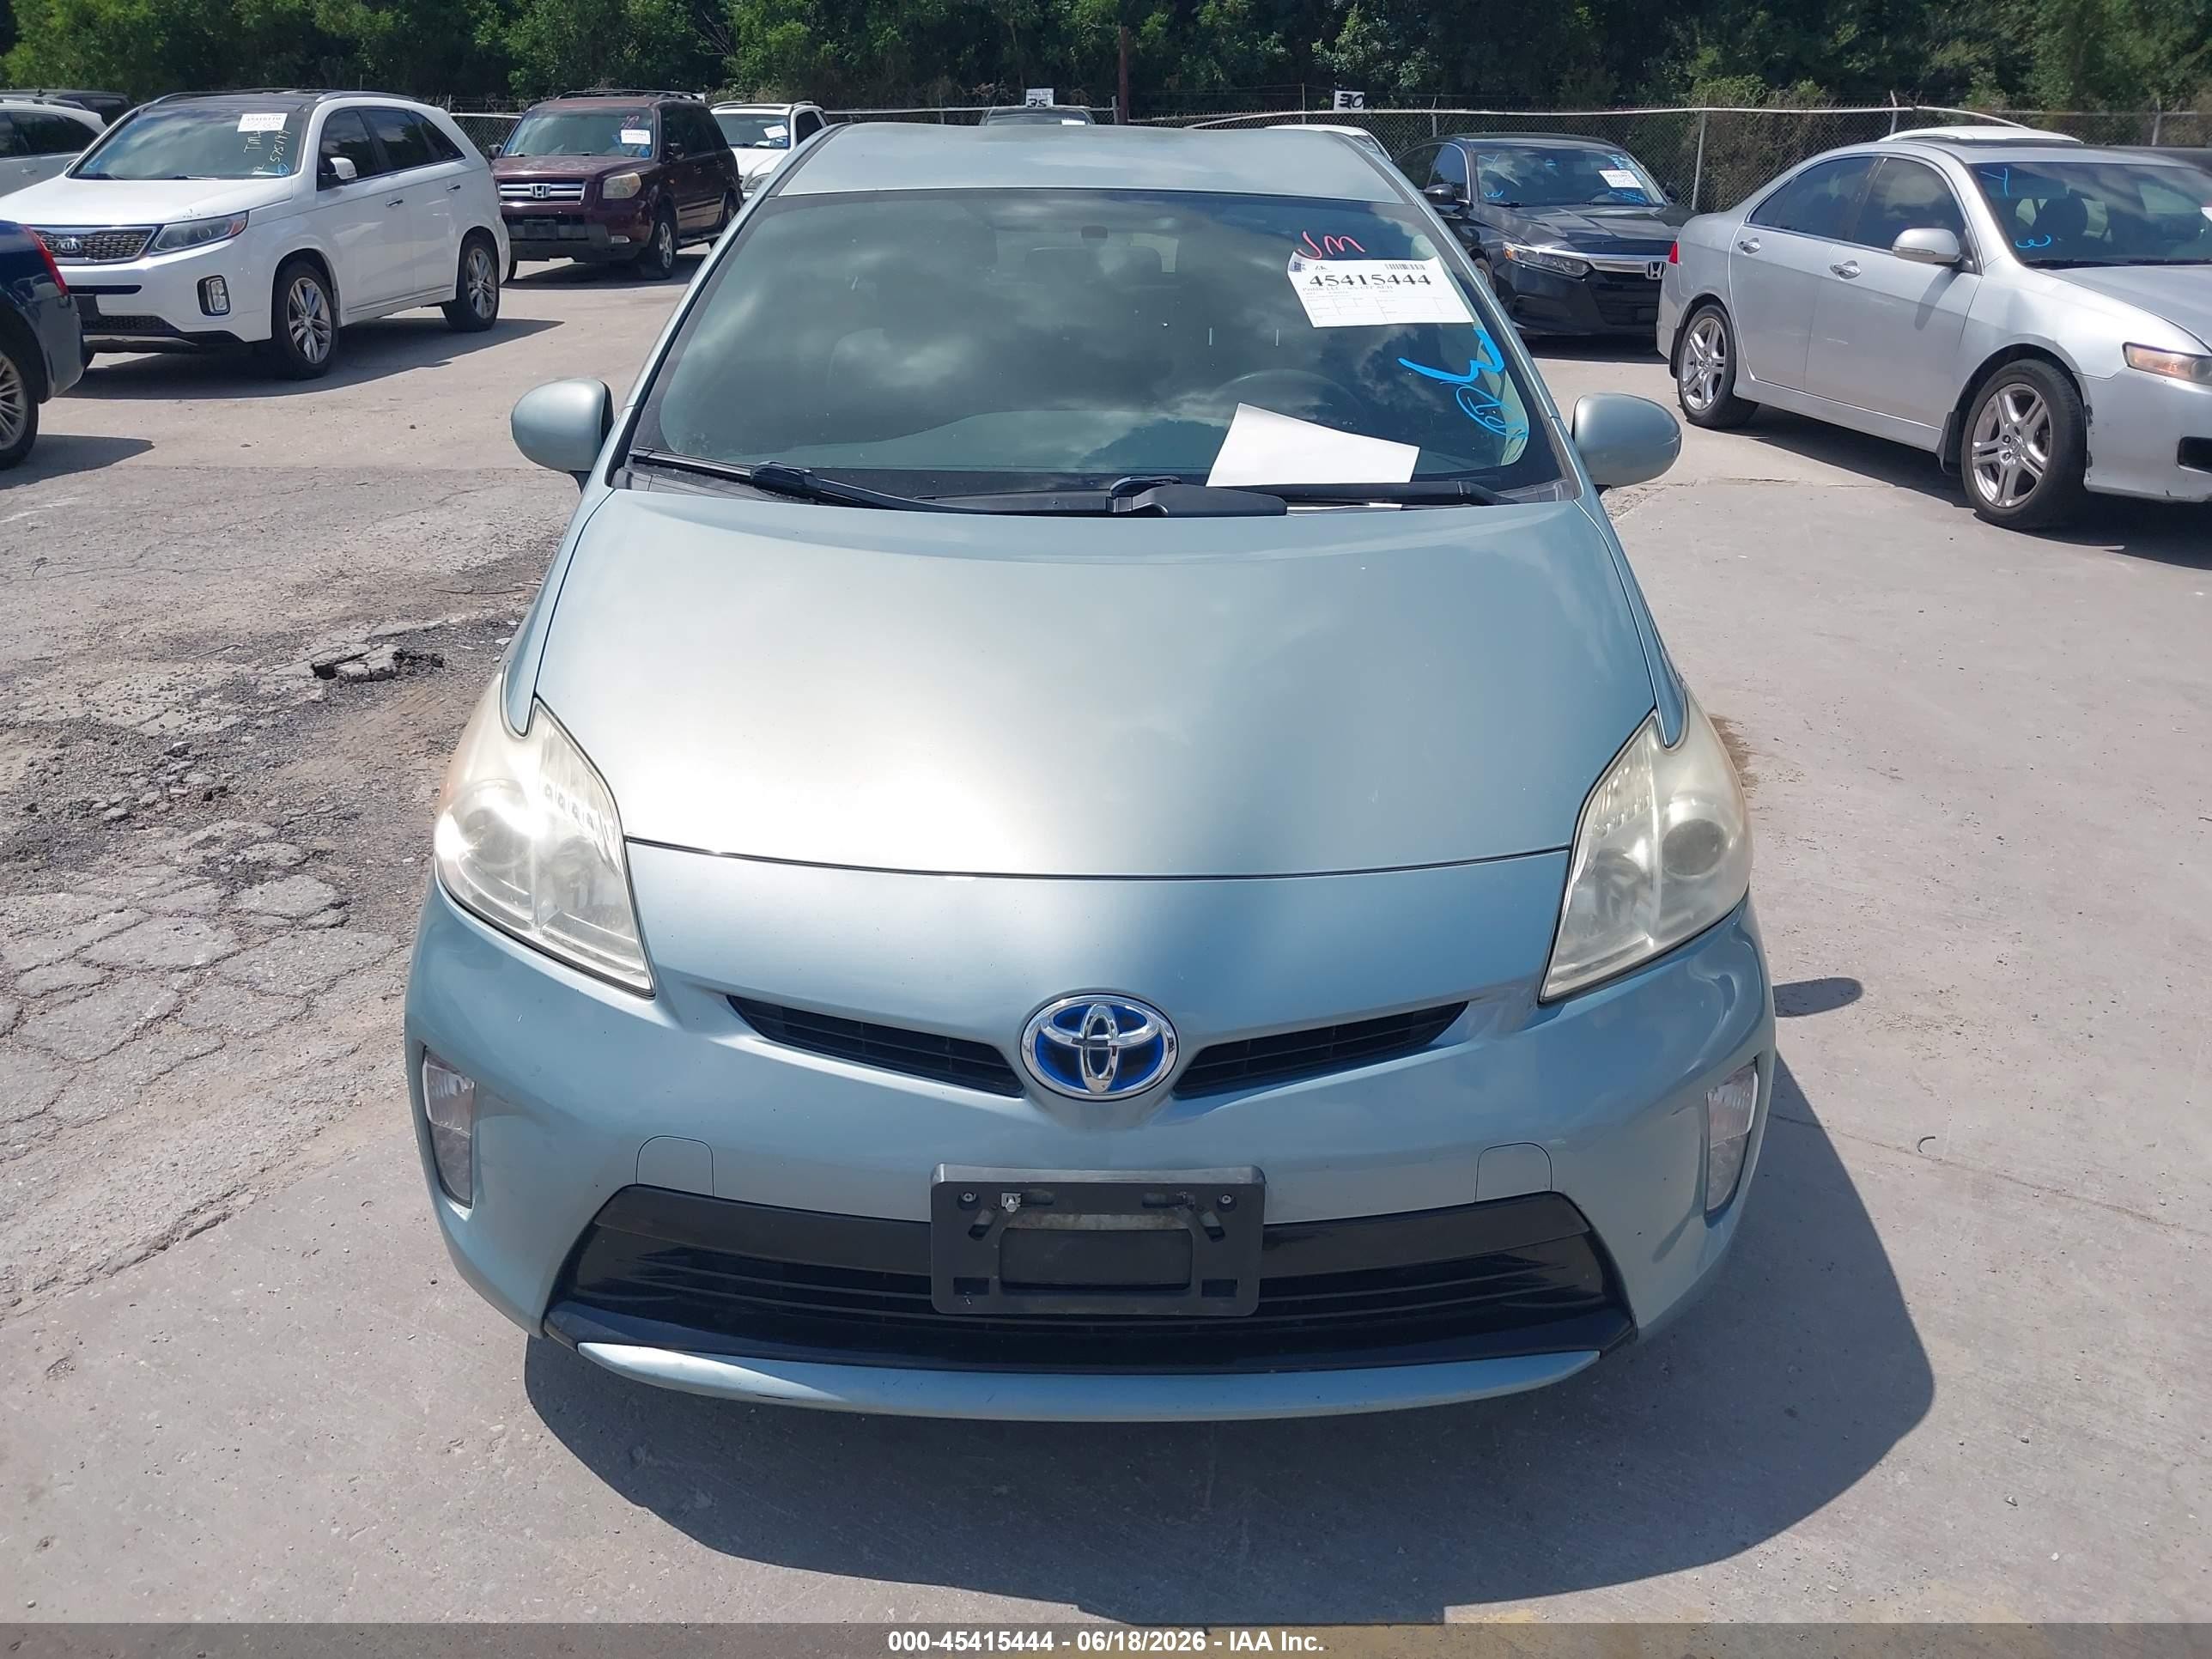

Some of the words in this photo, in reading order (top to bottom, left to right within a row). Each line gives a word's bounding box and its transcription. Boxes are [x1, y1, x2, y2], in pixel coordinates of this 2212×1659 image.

[1339, 93, 1364, 109] 30
[1297, 230, 1366, 259] JM
[1310, 274, 1432, 287] 45415444
